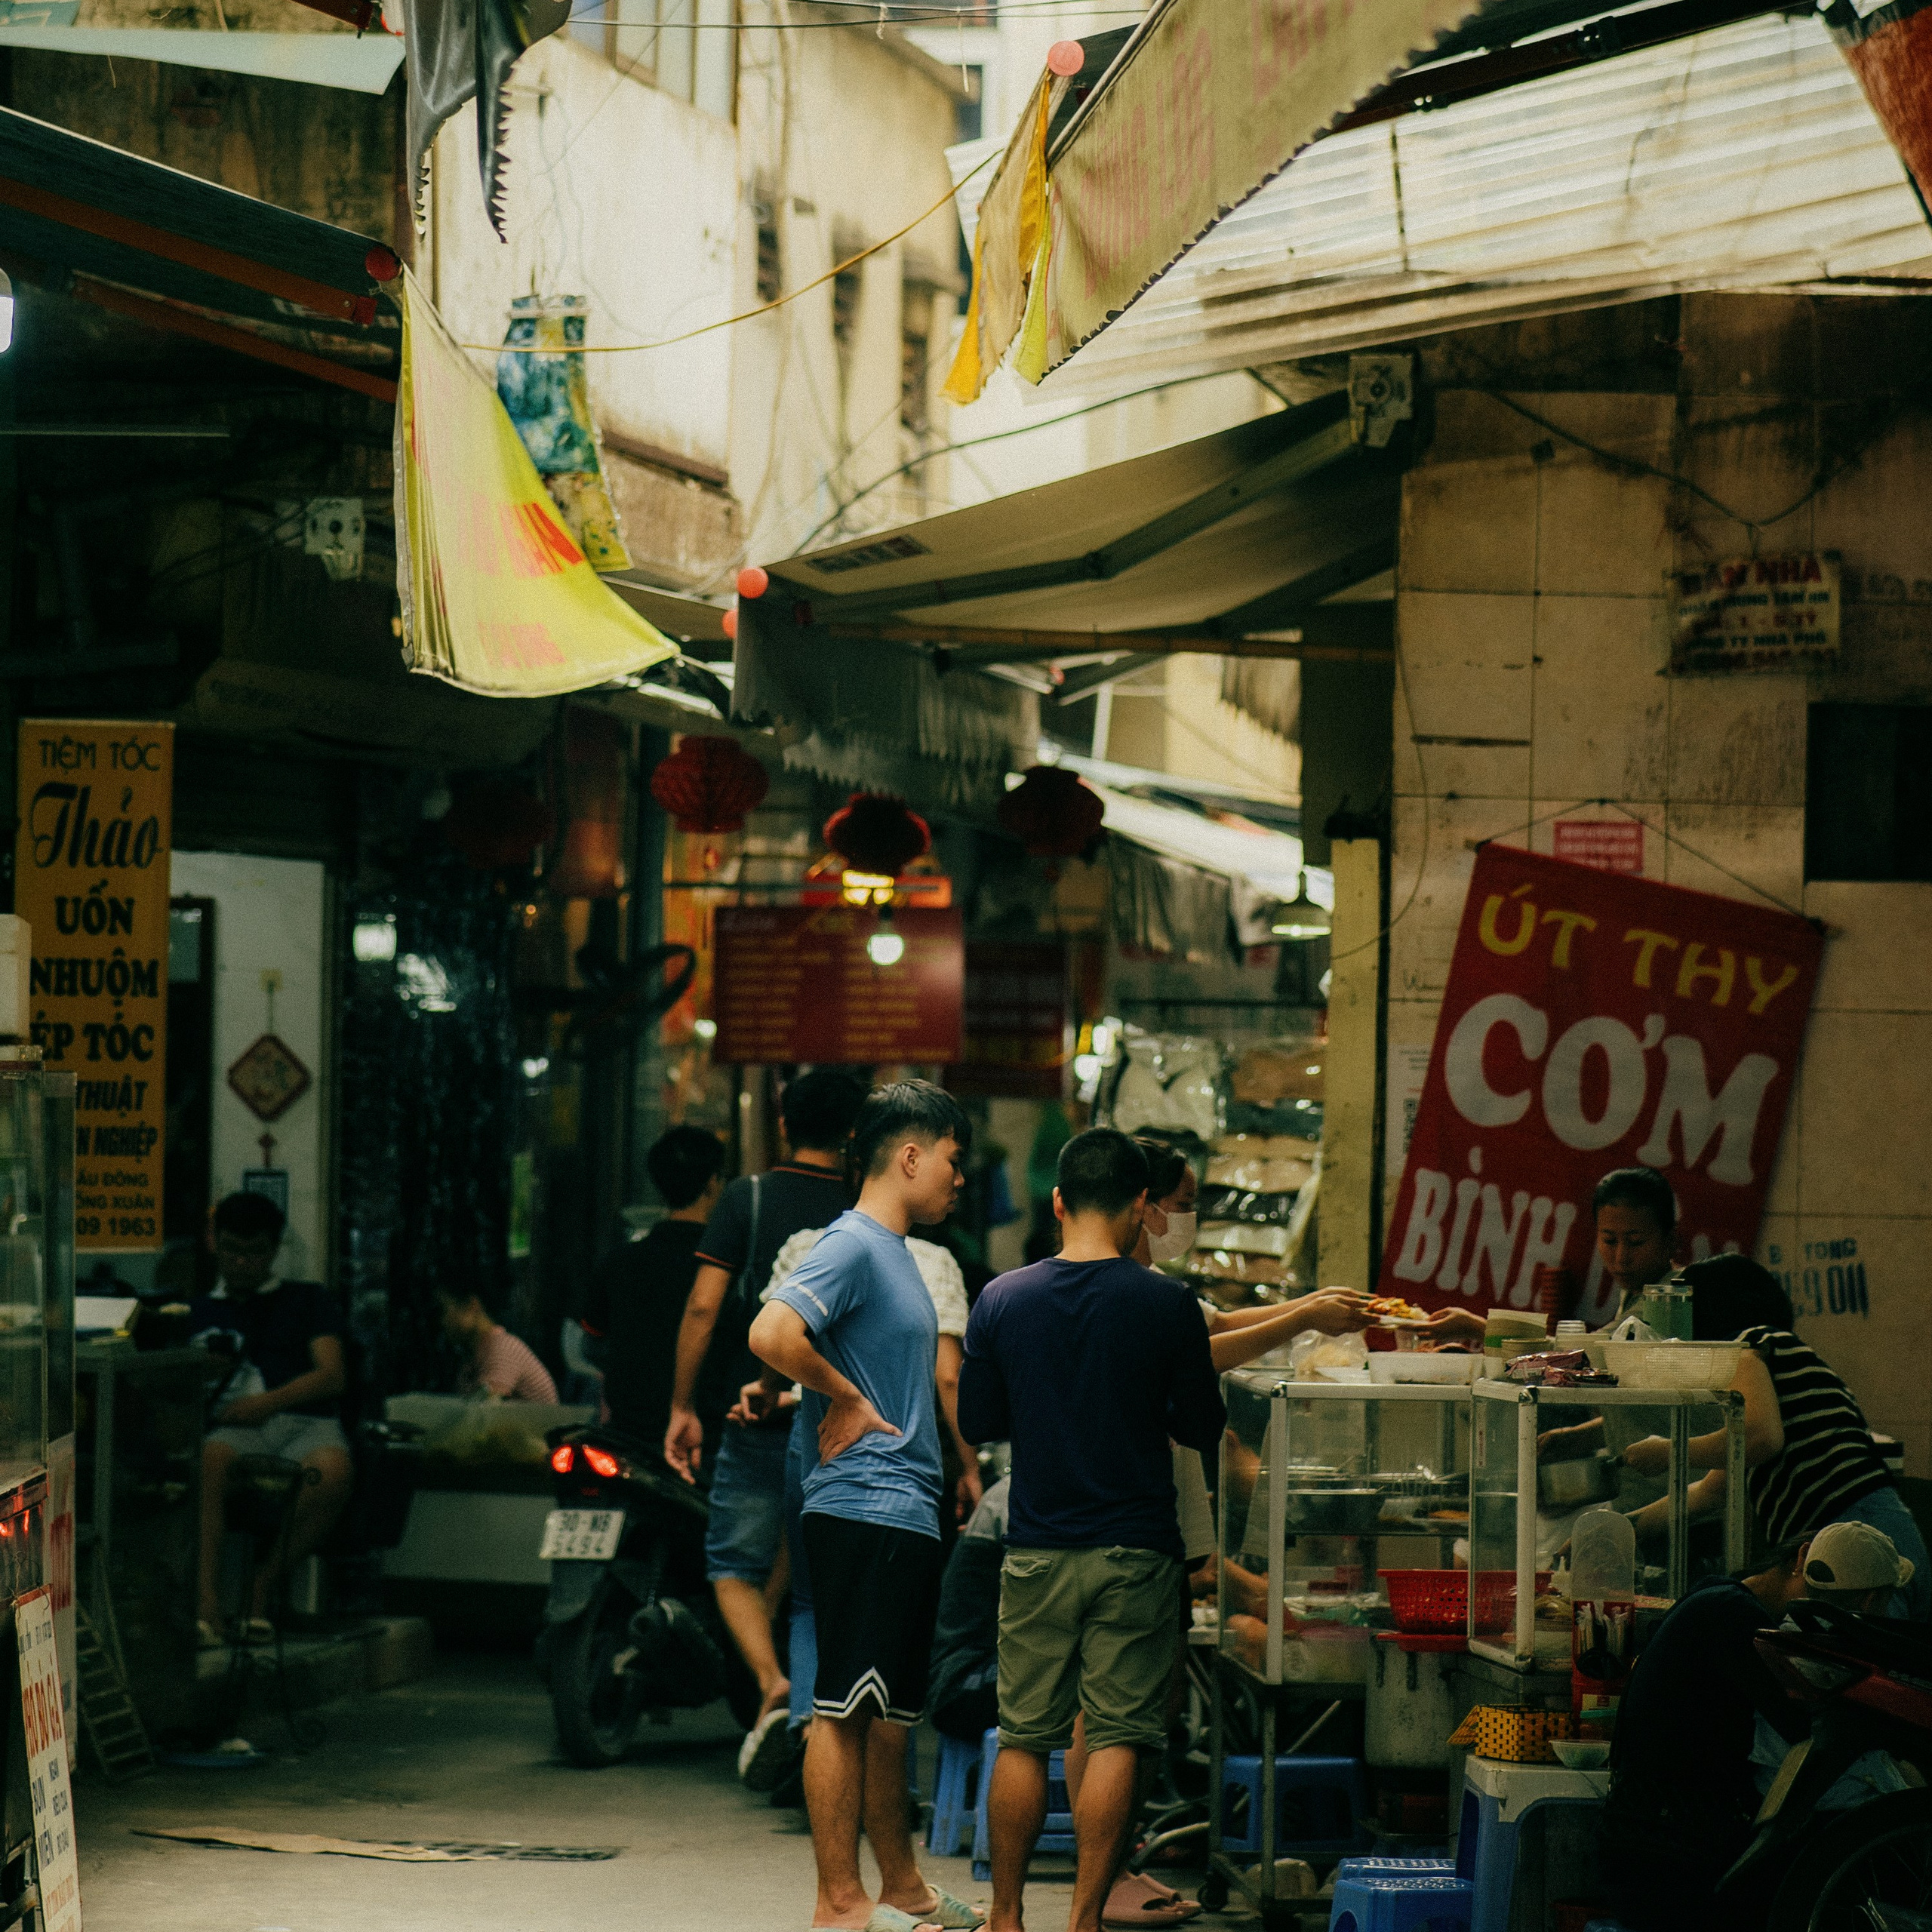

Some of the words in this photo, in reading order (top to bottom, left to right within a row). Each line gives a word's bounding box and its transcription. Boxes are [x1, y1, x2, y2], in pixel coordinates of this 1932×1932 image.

[38, 735, 97, 775] TIỆM
[109, 736, 162, 771] TÓC
[29, 781, 164, 869] Thảo
[54, 879, 135, 936] UỐN
[30, 947, 159, 1007] NHUỘM
[1477, 883, 1597, 971] ÚT
[1623, 928, 1801, 1015] THY
[82, 1012, 155, 1061] TÓC
[76, 1075, 149, 1117] THUẬT
[1444, 992, 1780, 1186] CƠM
[108, 1217, 156, 1235] 1963
